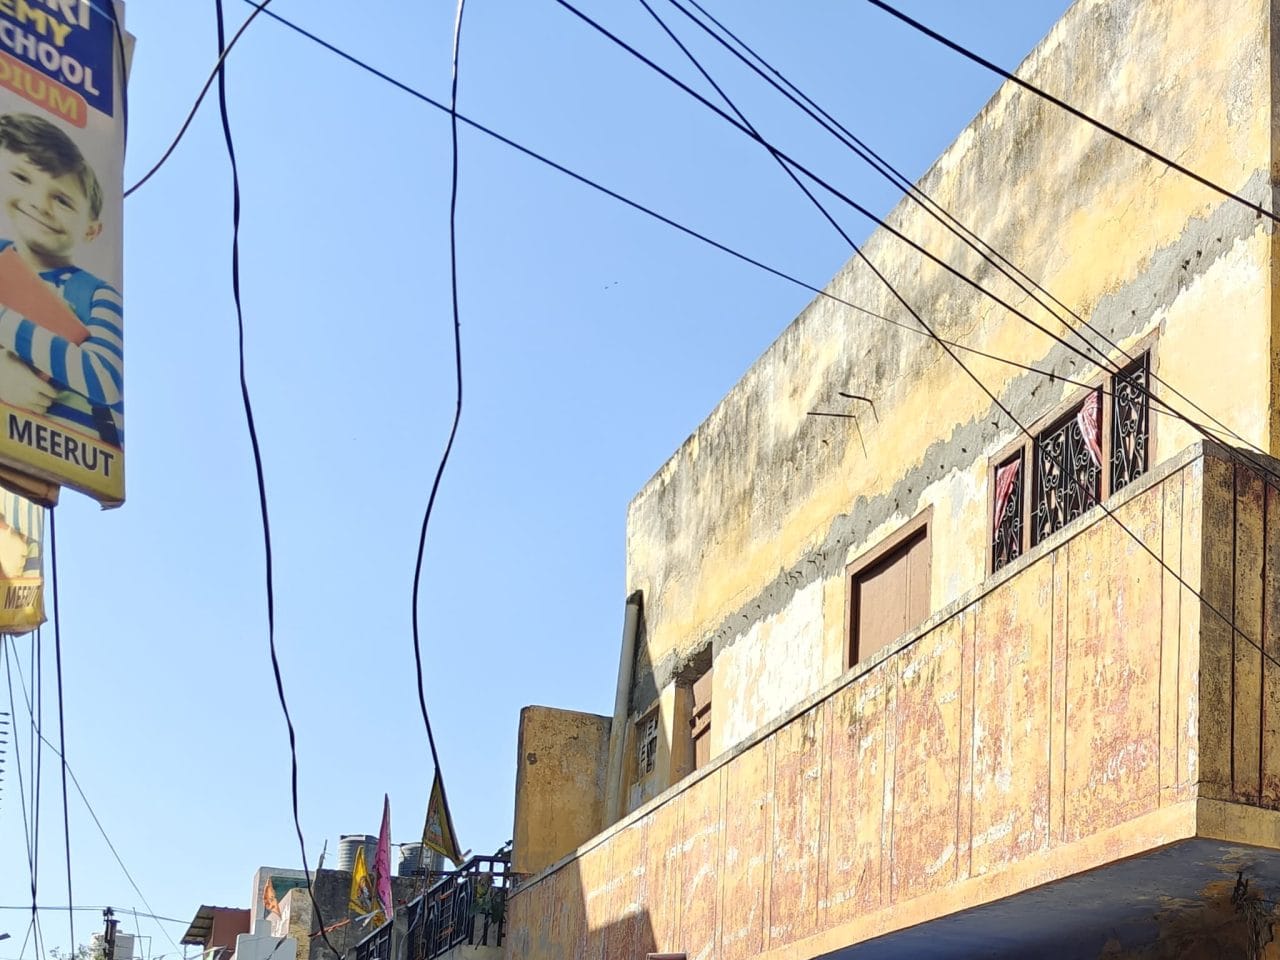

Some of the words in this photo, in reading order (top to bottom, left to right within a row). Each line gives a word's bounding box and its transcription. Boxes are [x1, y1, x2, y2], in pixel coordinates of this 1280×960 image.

[46, 0, 90, 31] RI
[0, 19, 100, 96] CHOOL
[8, 413, 115, 478] MEERUT
